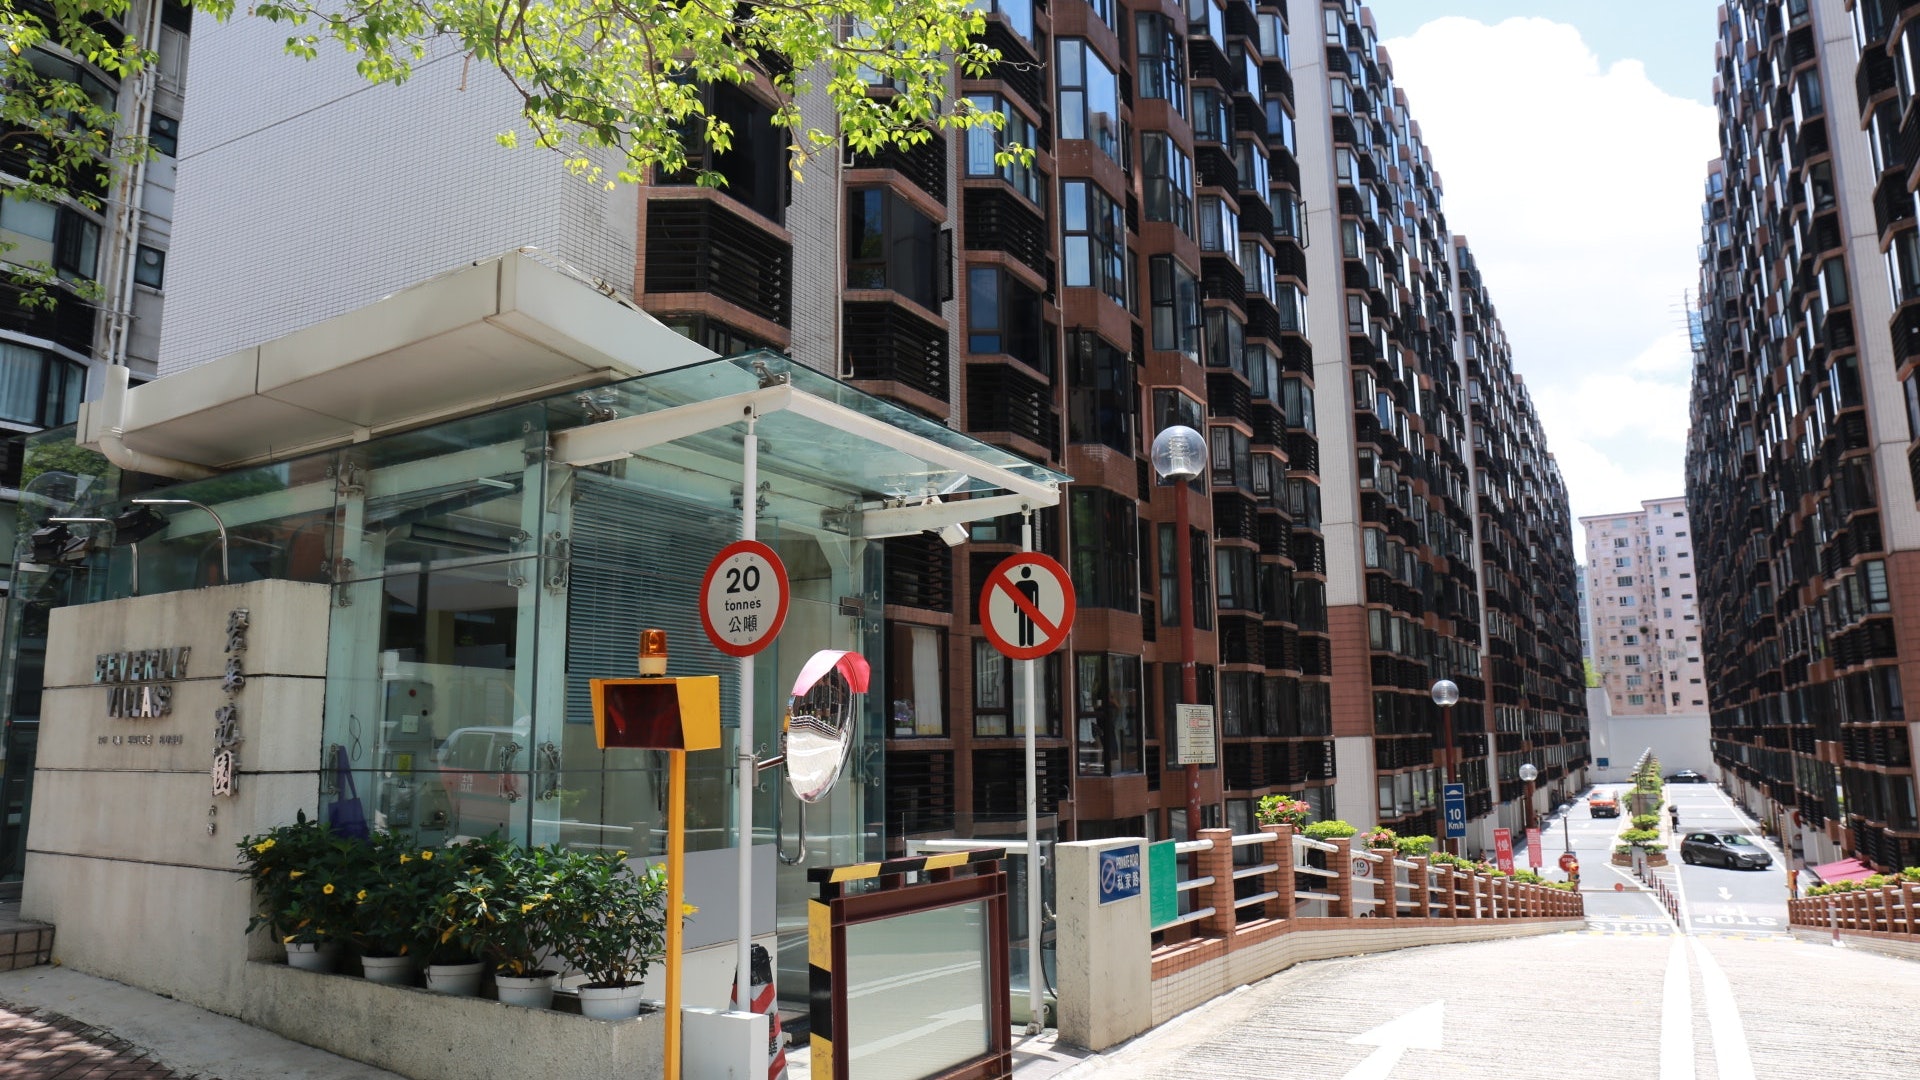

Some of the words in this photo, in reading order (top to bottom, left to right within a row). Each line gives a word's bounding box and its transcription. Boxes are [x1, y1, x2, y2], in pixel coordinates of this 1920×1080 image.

[726, 565, 760, 594] 20
[725, 599, 762, 611] tonnes
[728, 614, 758, 633] 公噸
[94, 646, 191, 682] BEVERLY
[106, 685, 172, 719] VILLAS
[1449, 808, 1462, 820] 10
[1695, 914, 1779, 926] STOP
